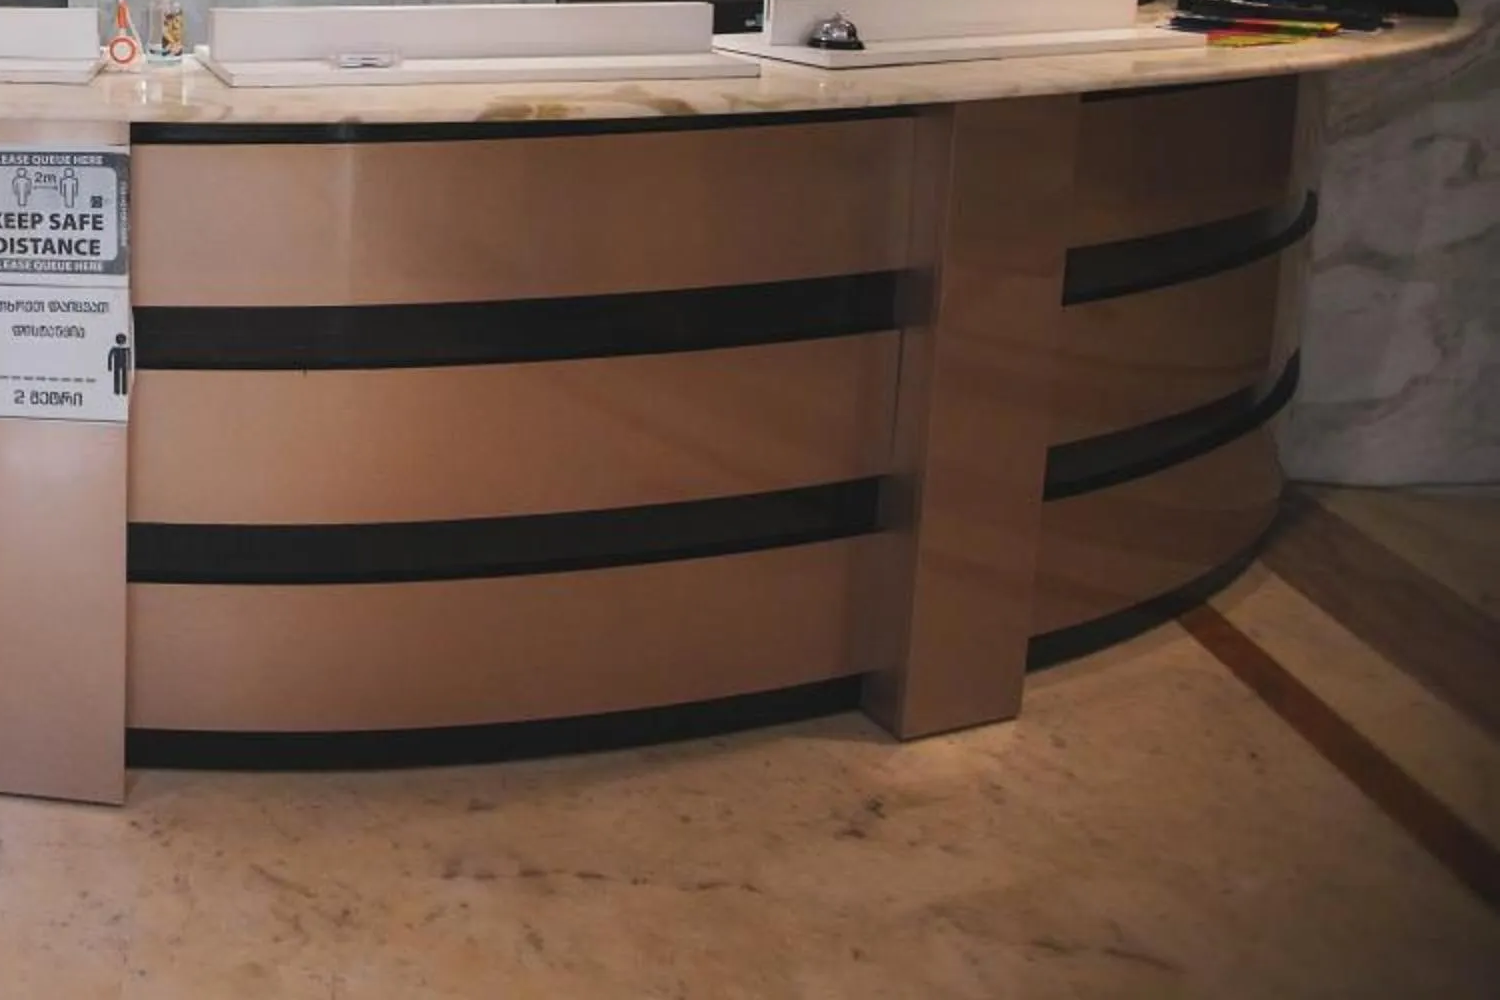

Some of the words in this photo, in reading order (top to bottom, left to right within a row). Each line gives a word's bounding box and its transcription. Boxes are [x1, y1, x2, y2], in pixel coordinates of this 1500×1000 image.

[31, 155, 73, 165] QUEUE
[73, 156, 104, 165] HERE
[34, 172, 57, 183] 2m
[49, 213, 104, 231] SAFE
[33, 260, 74, 271] QUEUE
[74, 261, 103, 271] HERE
[13, 389, 25, 404] 2
